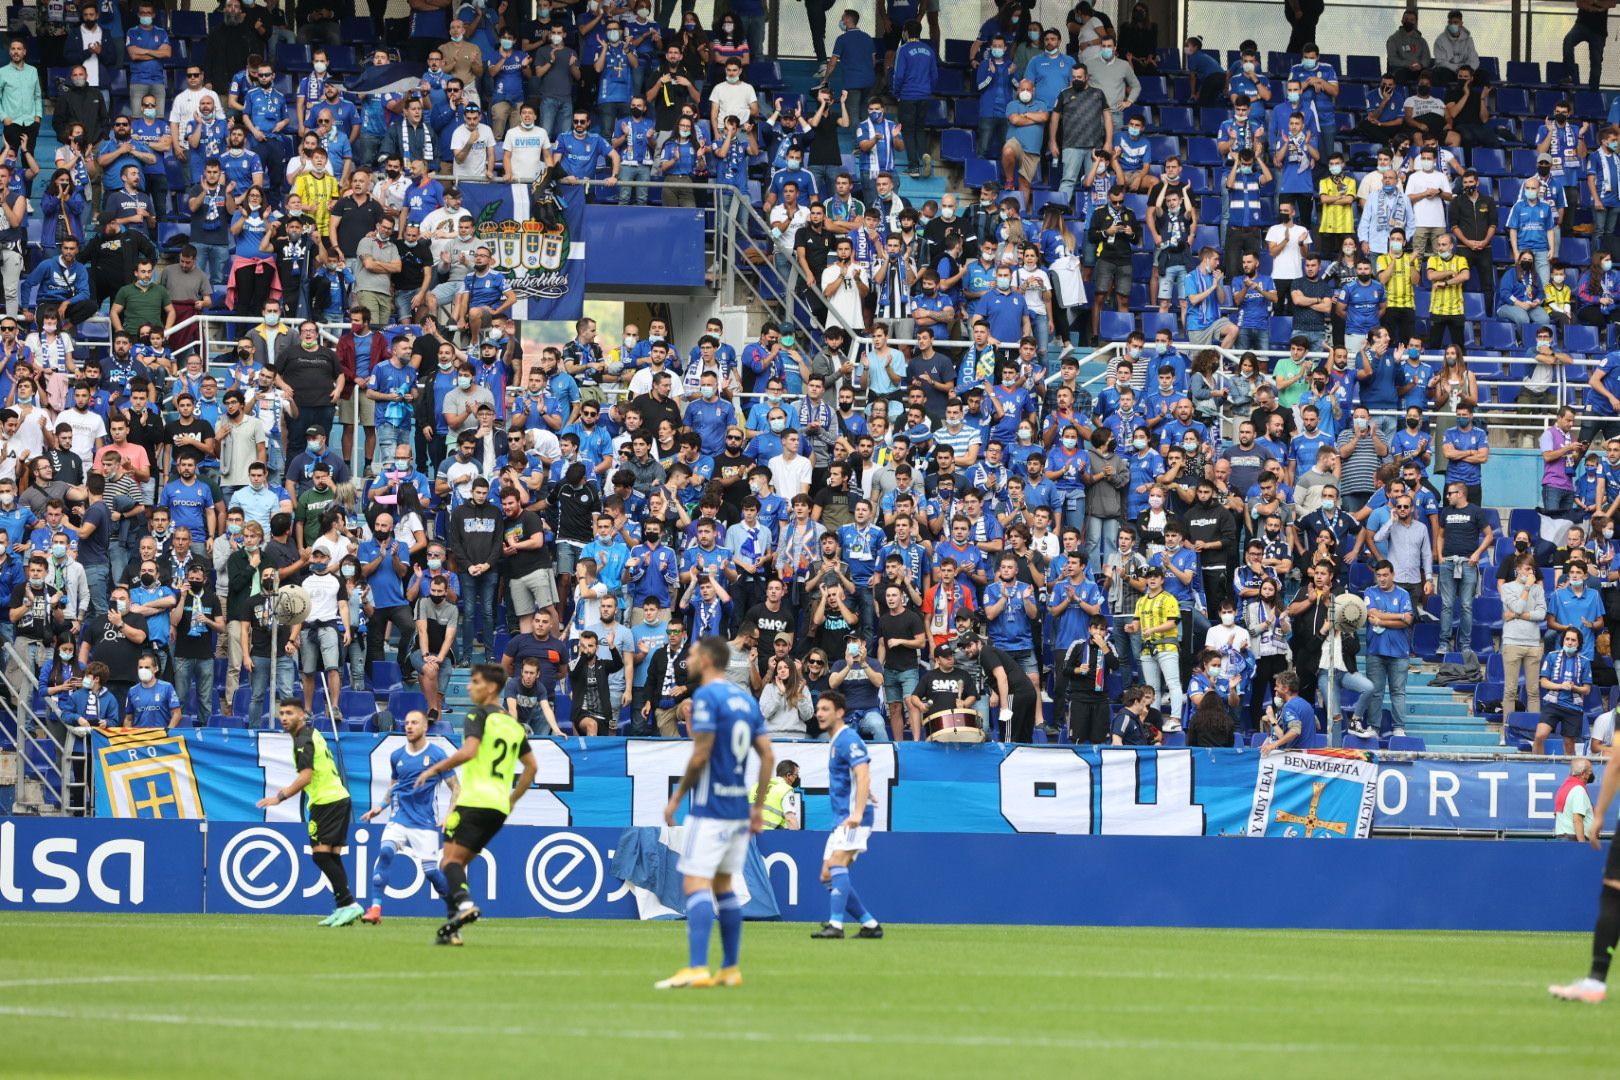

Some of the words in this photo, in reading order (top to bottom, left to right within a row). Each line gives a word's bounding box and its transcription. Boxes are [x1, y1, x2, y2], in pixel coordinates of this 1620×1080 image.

[515, 137, 541, 147] OVIEDO
[932, 679, 959, 691] SM9
[1410, 705, 1416, 714] 6
[731, 720, 751, 761] 9
[1442, 734, 1448, 744] 5
[127, 749, 138, 761] R
[145, 746, 157, 758] O
[491, 737, 518, 780] 21
[1284, 755, 1361, 776] BENEMERITA
[999, 746, 1206, 836] 94
[1260, 764, 1274, 793] LEAL
[1359, 780, 1377, 831] INVICTA
[1377, 768, 1556, 819] ORTE
[1253, 797, 1269, 822] MUY
